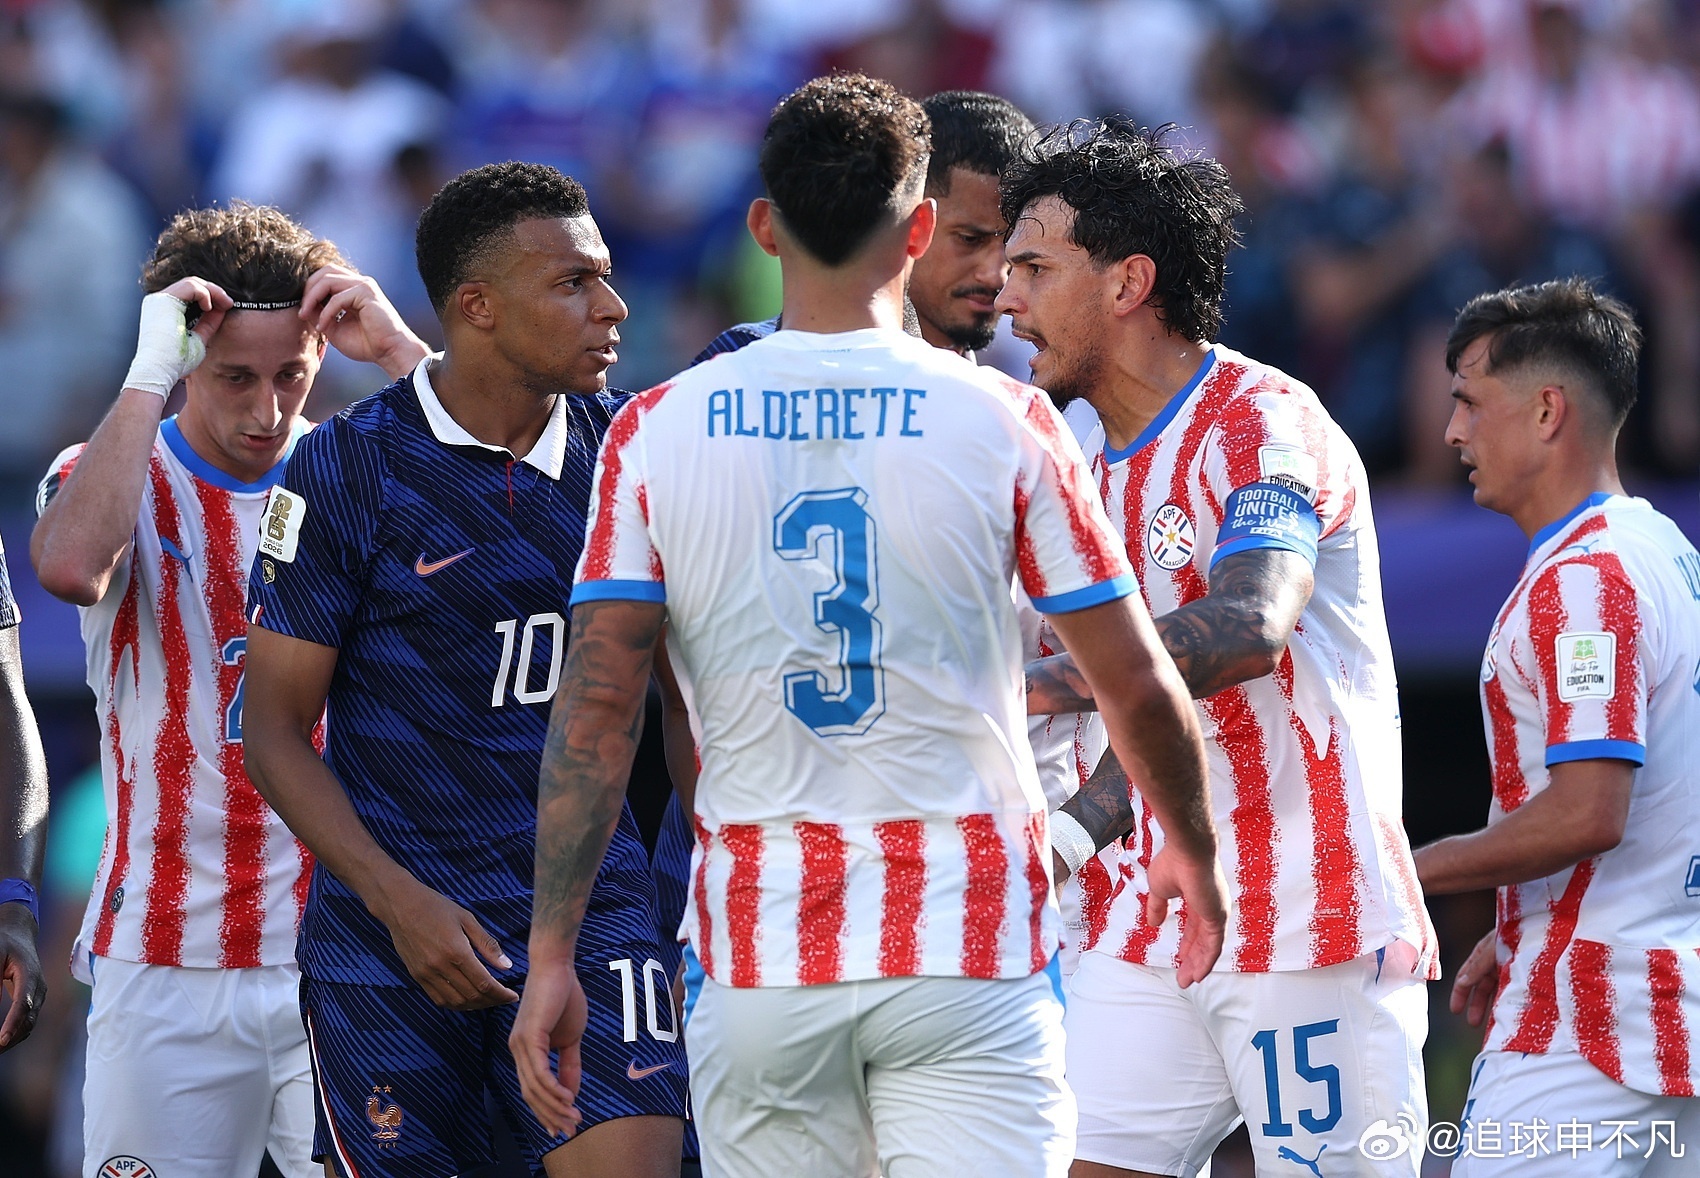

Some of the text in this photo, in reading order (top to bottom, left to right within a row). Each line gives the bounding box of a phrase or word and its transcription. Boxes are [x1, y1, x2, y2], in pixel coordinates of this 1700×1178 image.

[272, 301, 290, 309] THREE
[708, 387, 927, 441] ALDERETE
[1269, 476, 1311, 496] EDUCATION
[1237, 489, 1299, 513] FOOTBALL
[1163, 508, 1176, 520] APF
[1231, 517, 1256, 529] the
[1234, 501, 1299, 527] UNITES
[263, 541, 283, 555] 2026
[773, 486, 886, 738] 3
[492, 612, 565, 708] 10
[1566, 674, 1604, 686] EDUCATION
[608, 957, 679, 1044] 10
[1250, 1018, 1342, 1137] 15
[115, 1160, 136, 1170] APF
